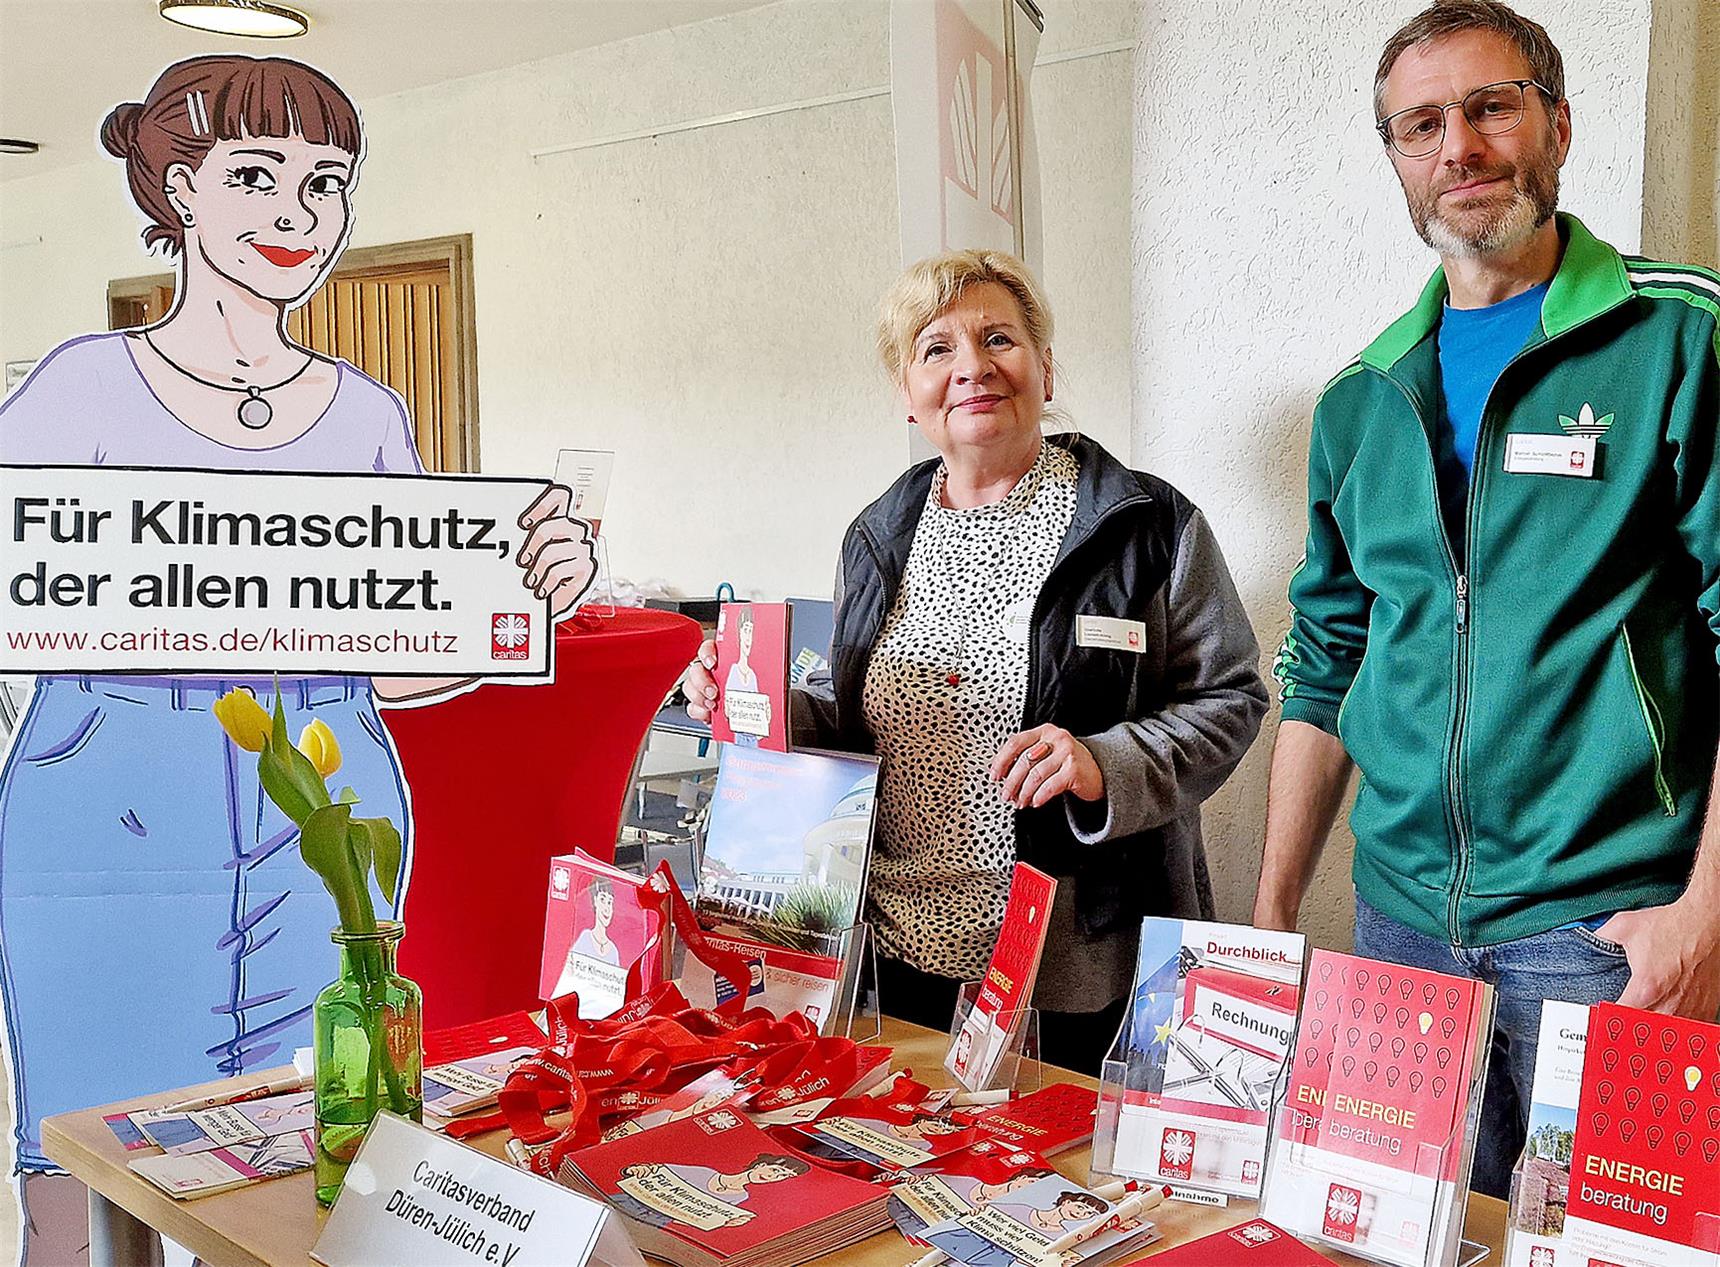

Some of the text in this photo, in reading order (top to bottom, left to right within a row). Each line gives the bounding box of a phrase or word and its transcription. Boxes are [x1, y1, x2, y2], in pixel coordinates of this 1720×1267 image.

[13, 497, 510, 559] Für Klimaschutz,
[9, 562, 453, 611] der allen nutzt.
[6, 627, 459, 655] www.caritas.de/klimaschutz
[493, 649, 528, 659] caritas
[1206, 941, 1287, 962] Durchblick
[1211, 1001, 1290, 1046] Rechnung
[797, 1076, 830, 1097] Jülich
[986, 1114, 1048, 1137] ENERGIE
[1334, 1093, 1417, 1130] ENERGIE
[1328, 1120, 1402, 1156] beratung
[651, 1173, 674, 1190] Für
[1160, 1166, 1189, 1180] caritas
[1584, 1154, 1685, 1197] ENERGIE
[412, 1159, 536, 1233] Caritasverband
[638, 1178, 659, 1196] der
[655, 1191, 682, 1208] allen
[1580, 1181, 1668, 1226] beratung
[384, 1188, 487, 1257] Düren-Jülich
[965, 1219, 996, 1242] Klima
[975, 1215, 1024, 1243] muss viel
[1006, 1220, 1027, 1235] viel
[1024, 1231, 1051, 1248] Geld
